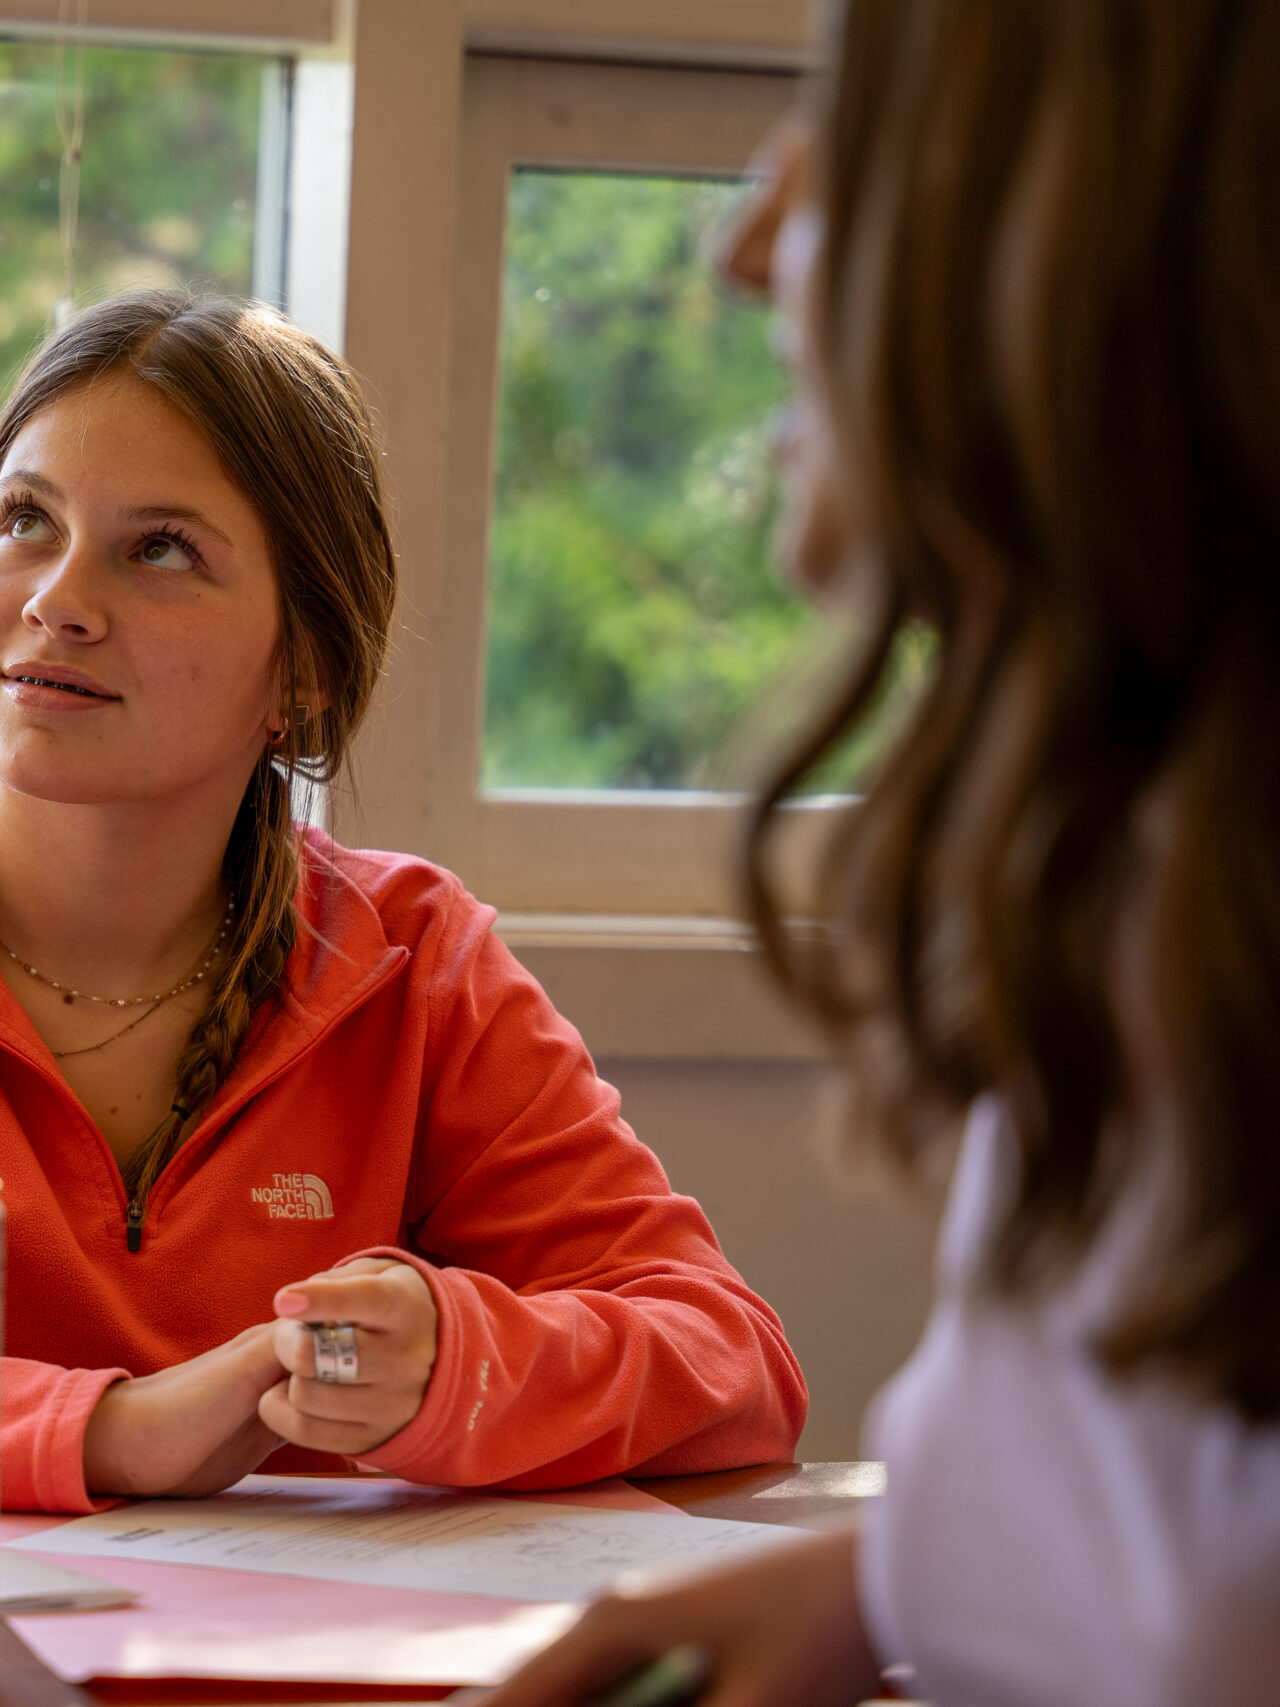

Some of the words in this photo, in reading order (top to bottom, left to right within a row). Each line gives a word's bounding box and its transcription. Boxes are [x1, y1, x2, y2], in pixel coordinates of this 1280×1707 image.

[272, 1173, 304, 1189] THE
[251, 1187, 305, 1204] NORTH
[268, 1203, 307, 1219] FACE
